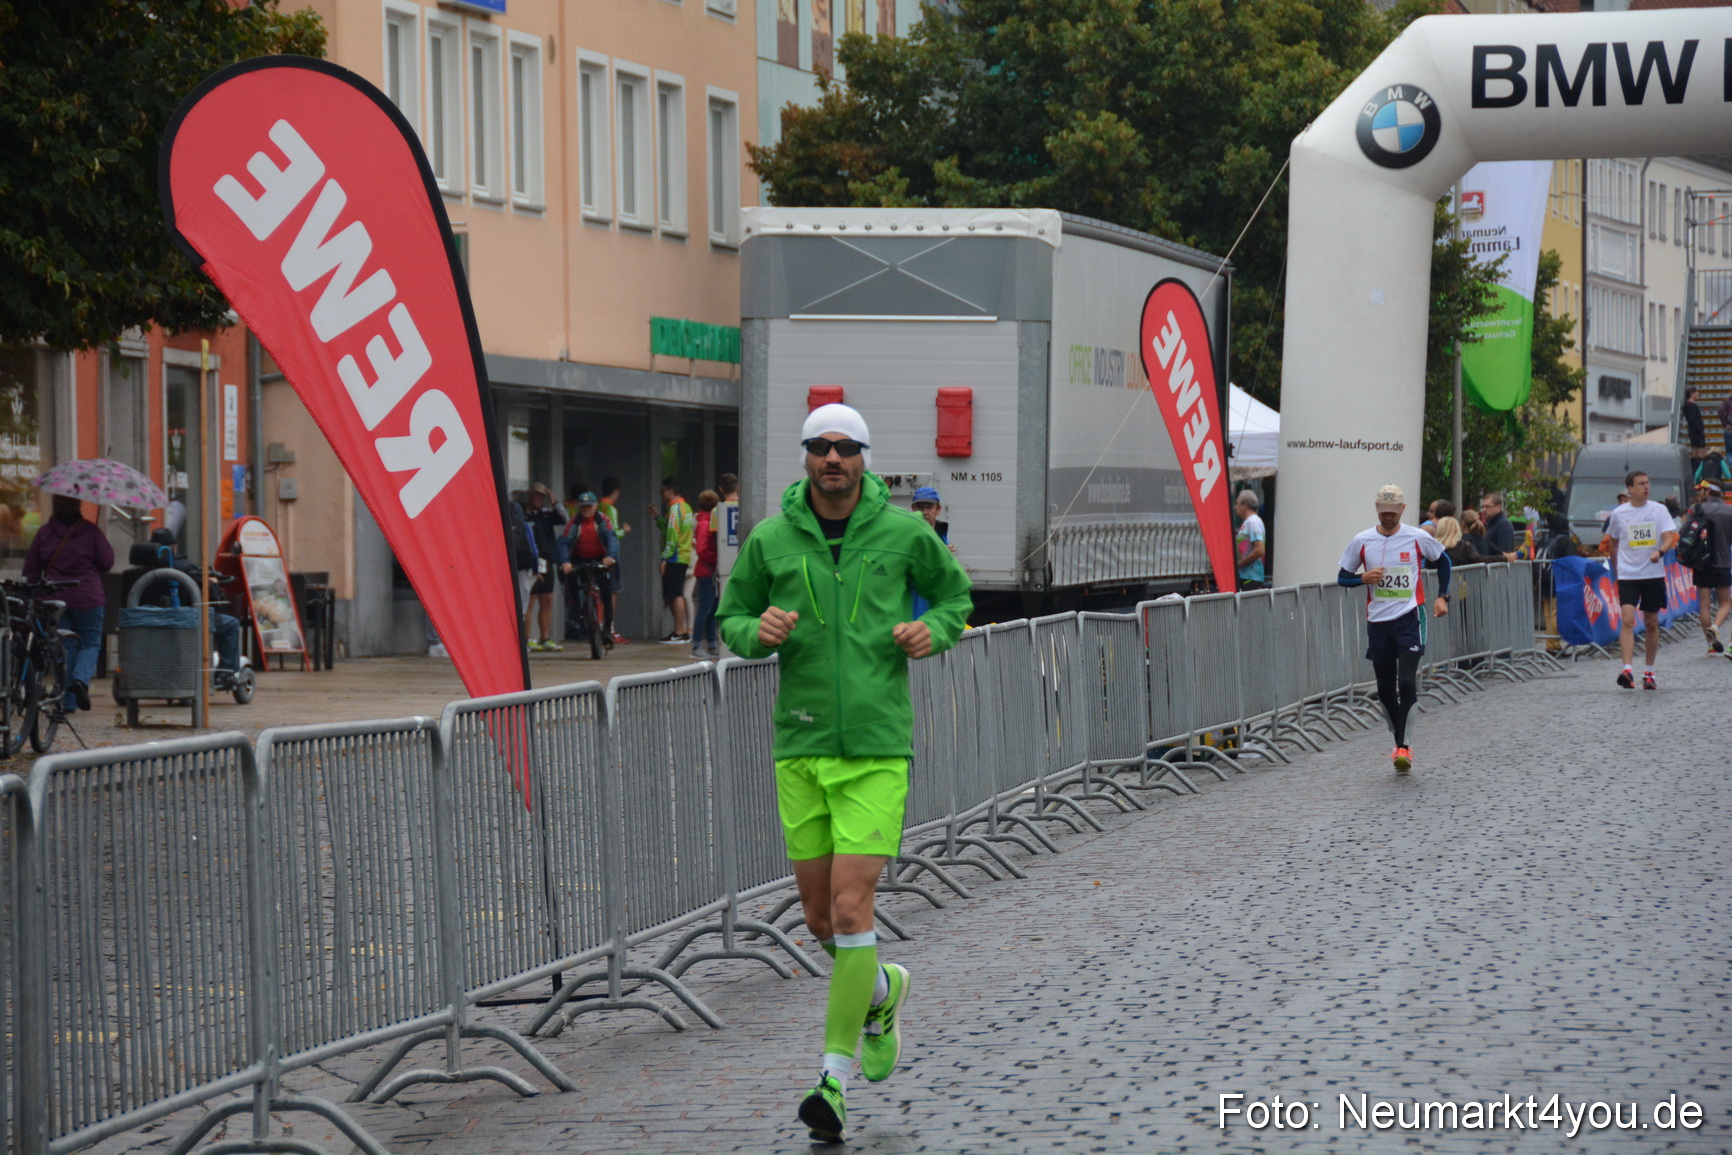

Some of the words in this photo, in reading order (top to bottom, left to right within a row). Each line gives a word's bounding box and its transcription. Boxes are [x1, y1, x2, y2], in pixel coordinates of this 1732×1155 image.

[1471, 39, 1700, 109] BMW
[1363, 86, 1432, 117] BMW
[1286, 438, 1404, 452] www.bmw-laufsport.de
[951, 472, 968, 481] NM
[981, 472, 1003, 482] 1105
[1633, 529, 1652, 540] 264
